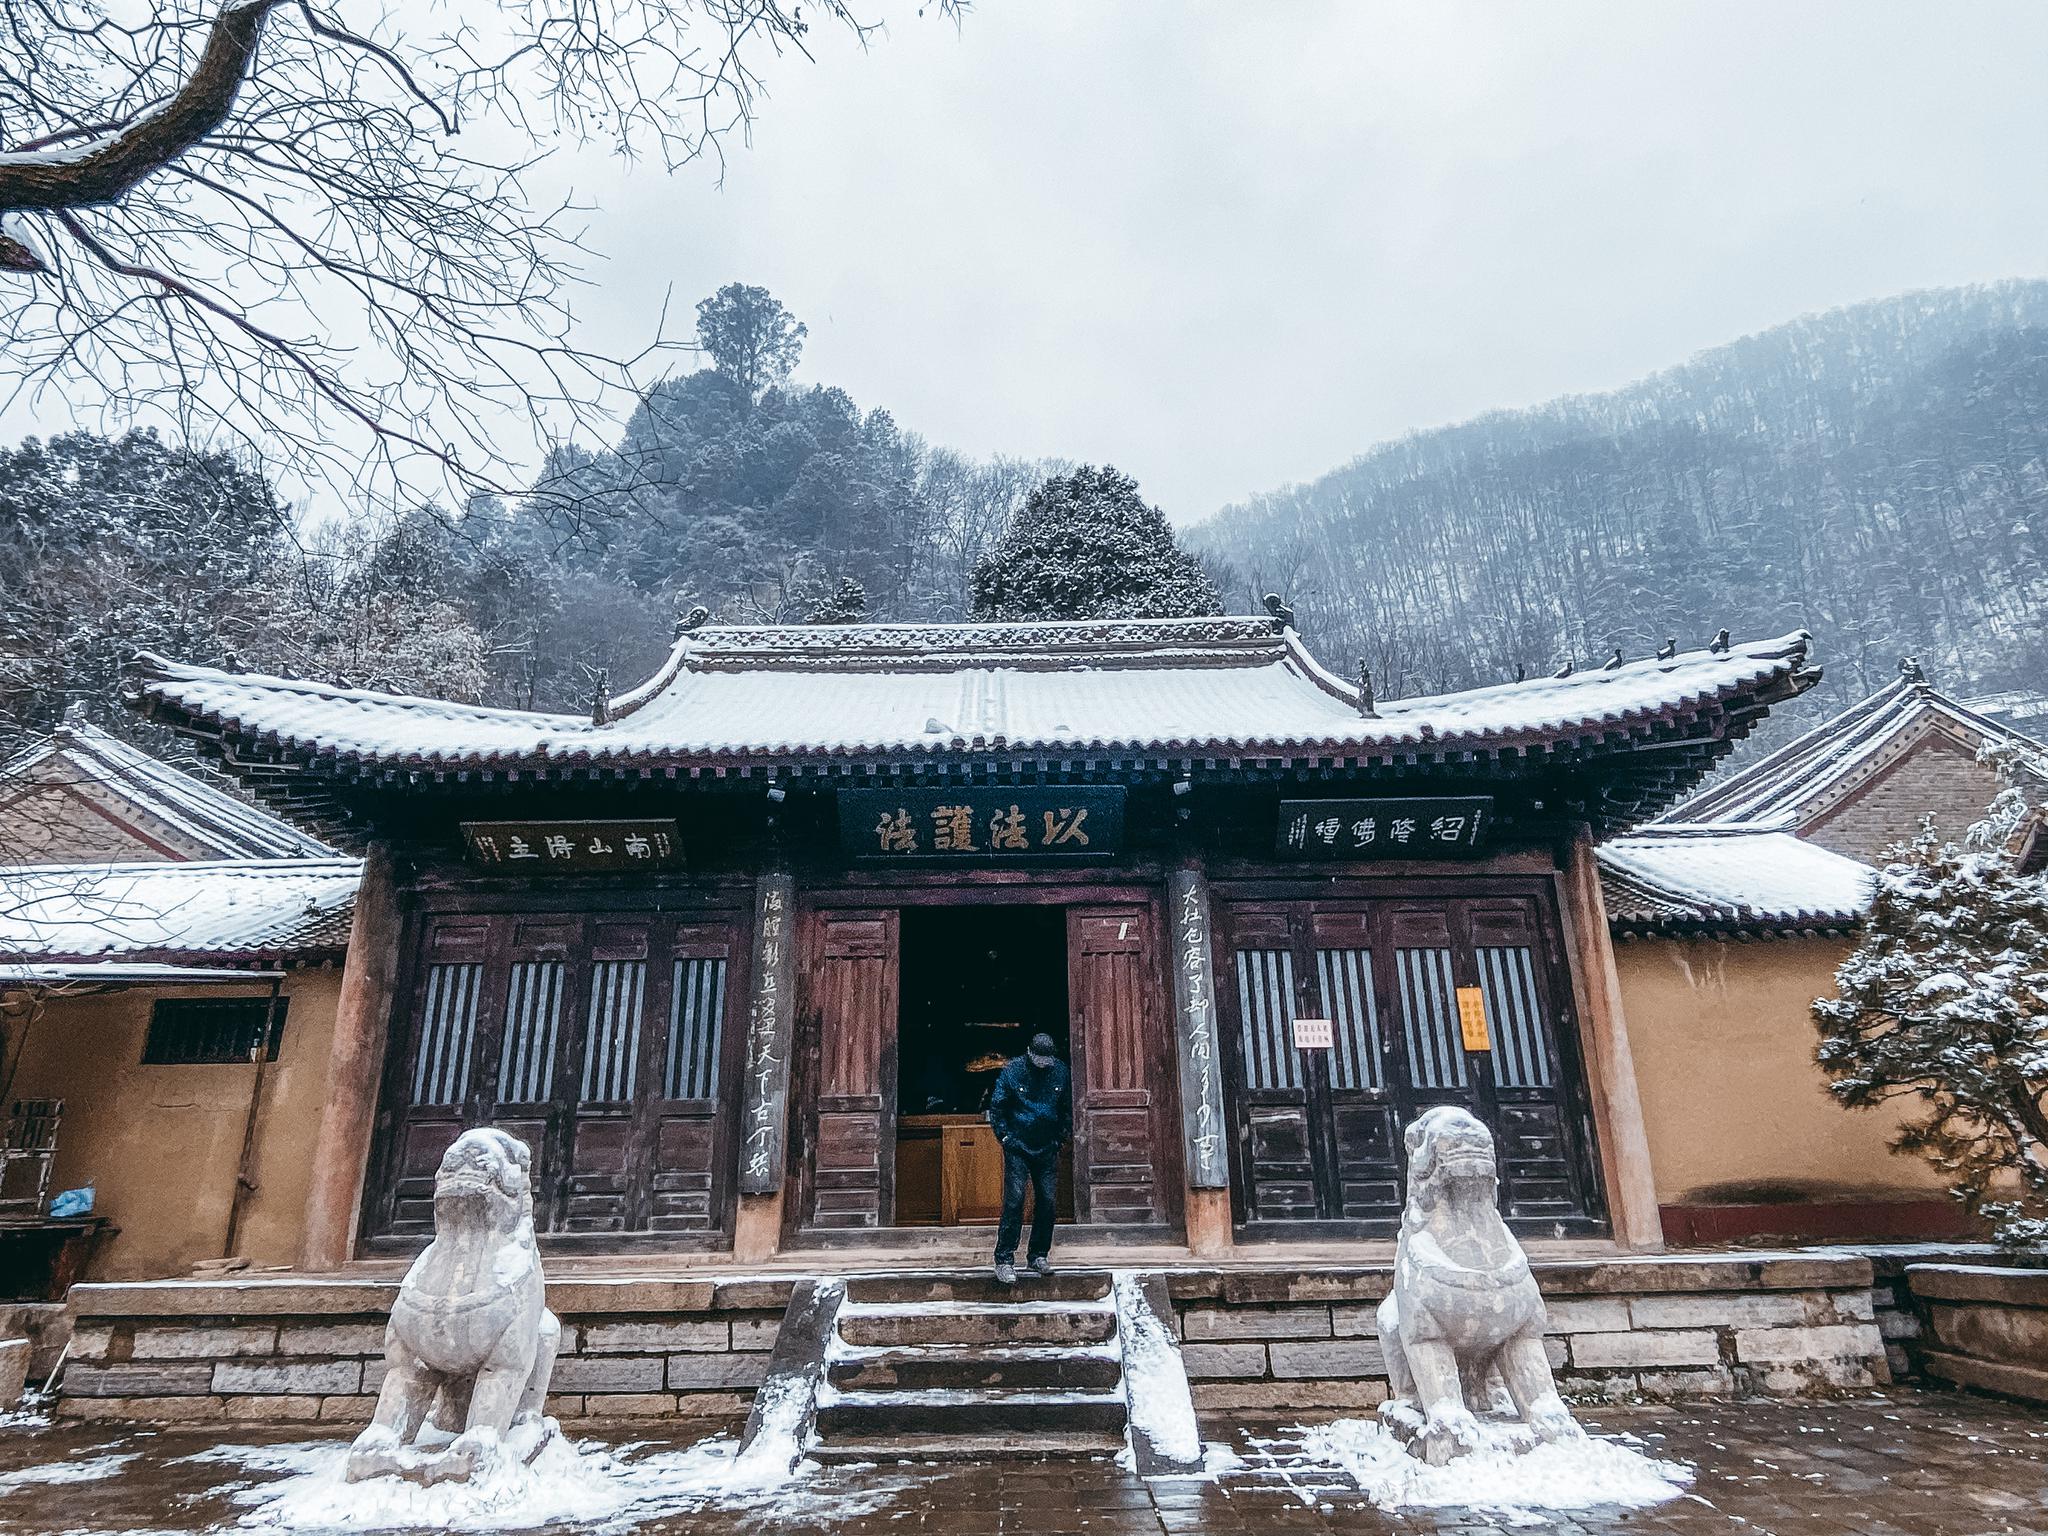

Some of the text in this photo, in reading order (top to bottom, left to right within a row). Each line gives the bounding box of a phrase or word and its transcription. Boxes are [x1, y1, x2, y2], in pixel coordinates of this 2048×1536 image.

[874, 804, 1090, 851] 以法護法
[1314, 816, 1466, 848] 紹隆佛種
